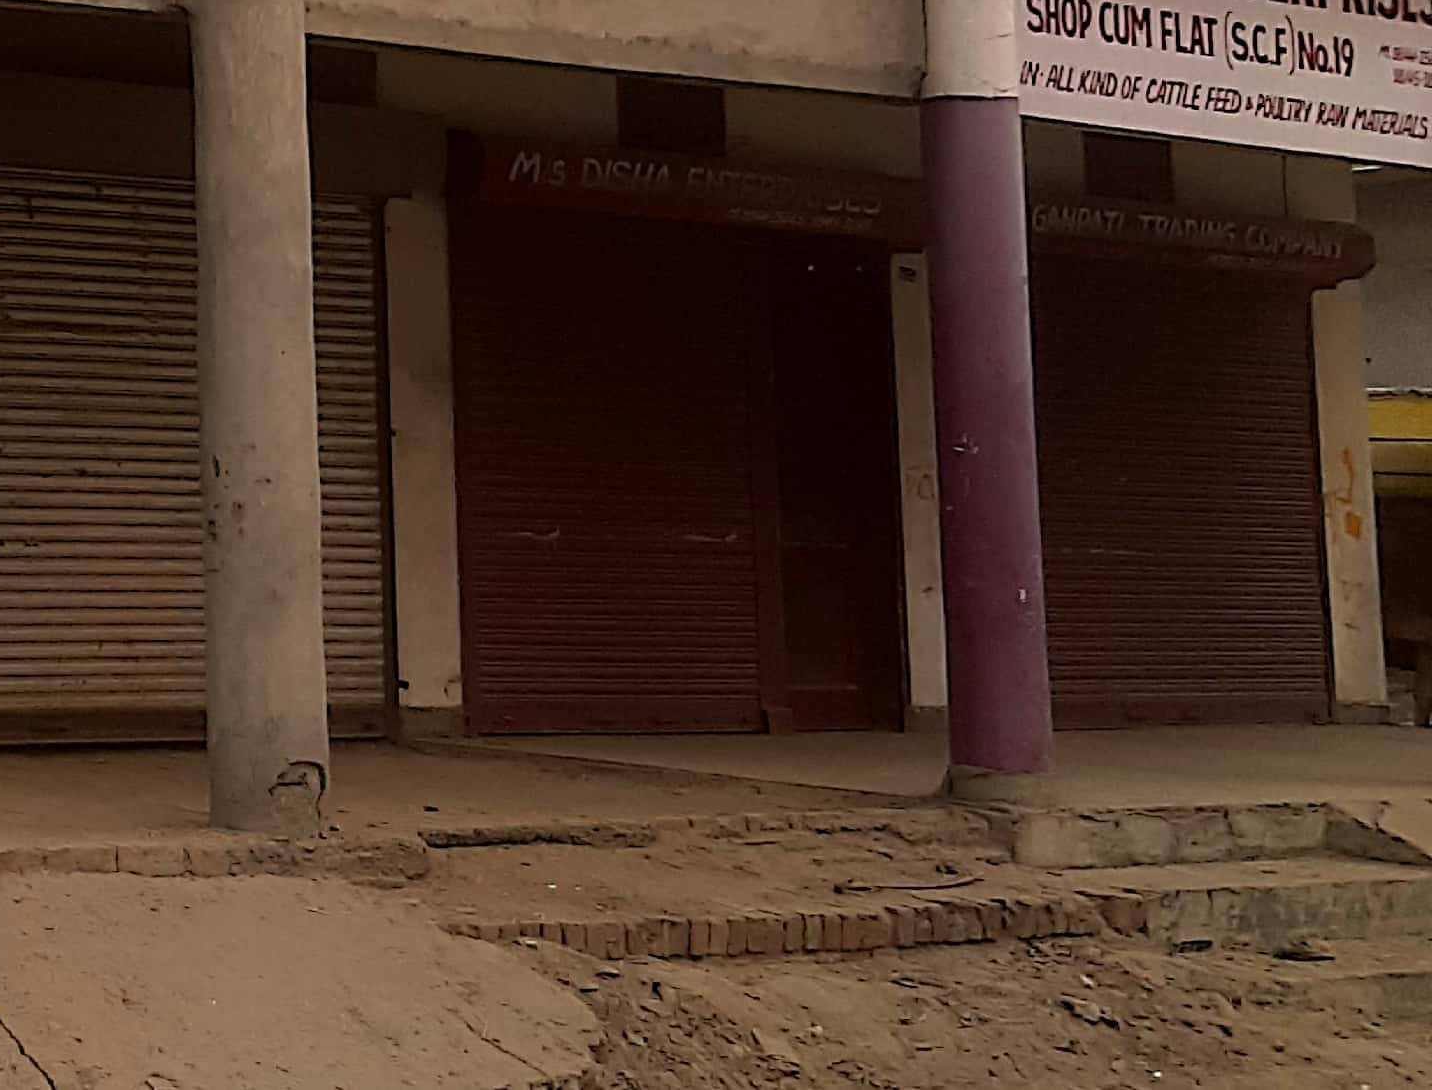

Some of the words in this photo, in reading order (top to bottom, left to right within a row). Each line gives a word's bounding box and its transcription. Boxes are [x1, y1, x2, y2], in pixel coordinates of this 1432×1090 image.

[1099, 2, 1150, 48] CUM
[1160, 11, 1218, 58] FLAT
[1047, 65, 1075, 94] ALL
[1078, 71, 1117, 98] KIND
[1120, 75, 1144, 101] OF
[1145, 78, 1200, 112] CATTLE
[1205, 86, 1242, 115] FEED
[1256, 94, 1311, 124] POULTRY
[1316, 102, 1349, 128] RAW
[1352, 106, 1429, 140] MATERIALS
[581, 157, 671, 190] DISHA
[1032, 203, 1126, 234] GANPATI
[1138, 213, 1236, 244] TRADING
